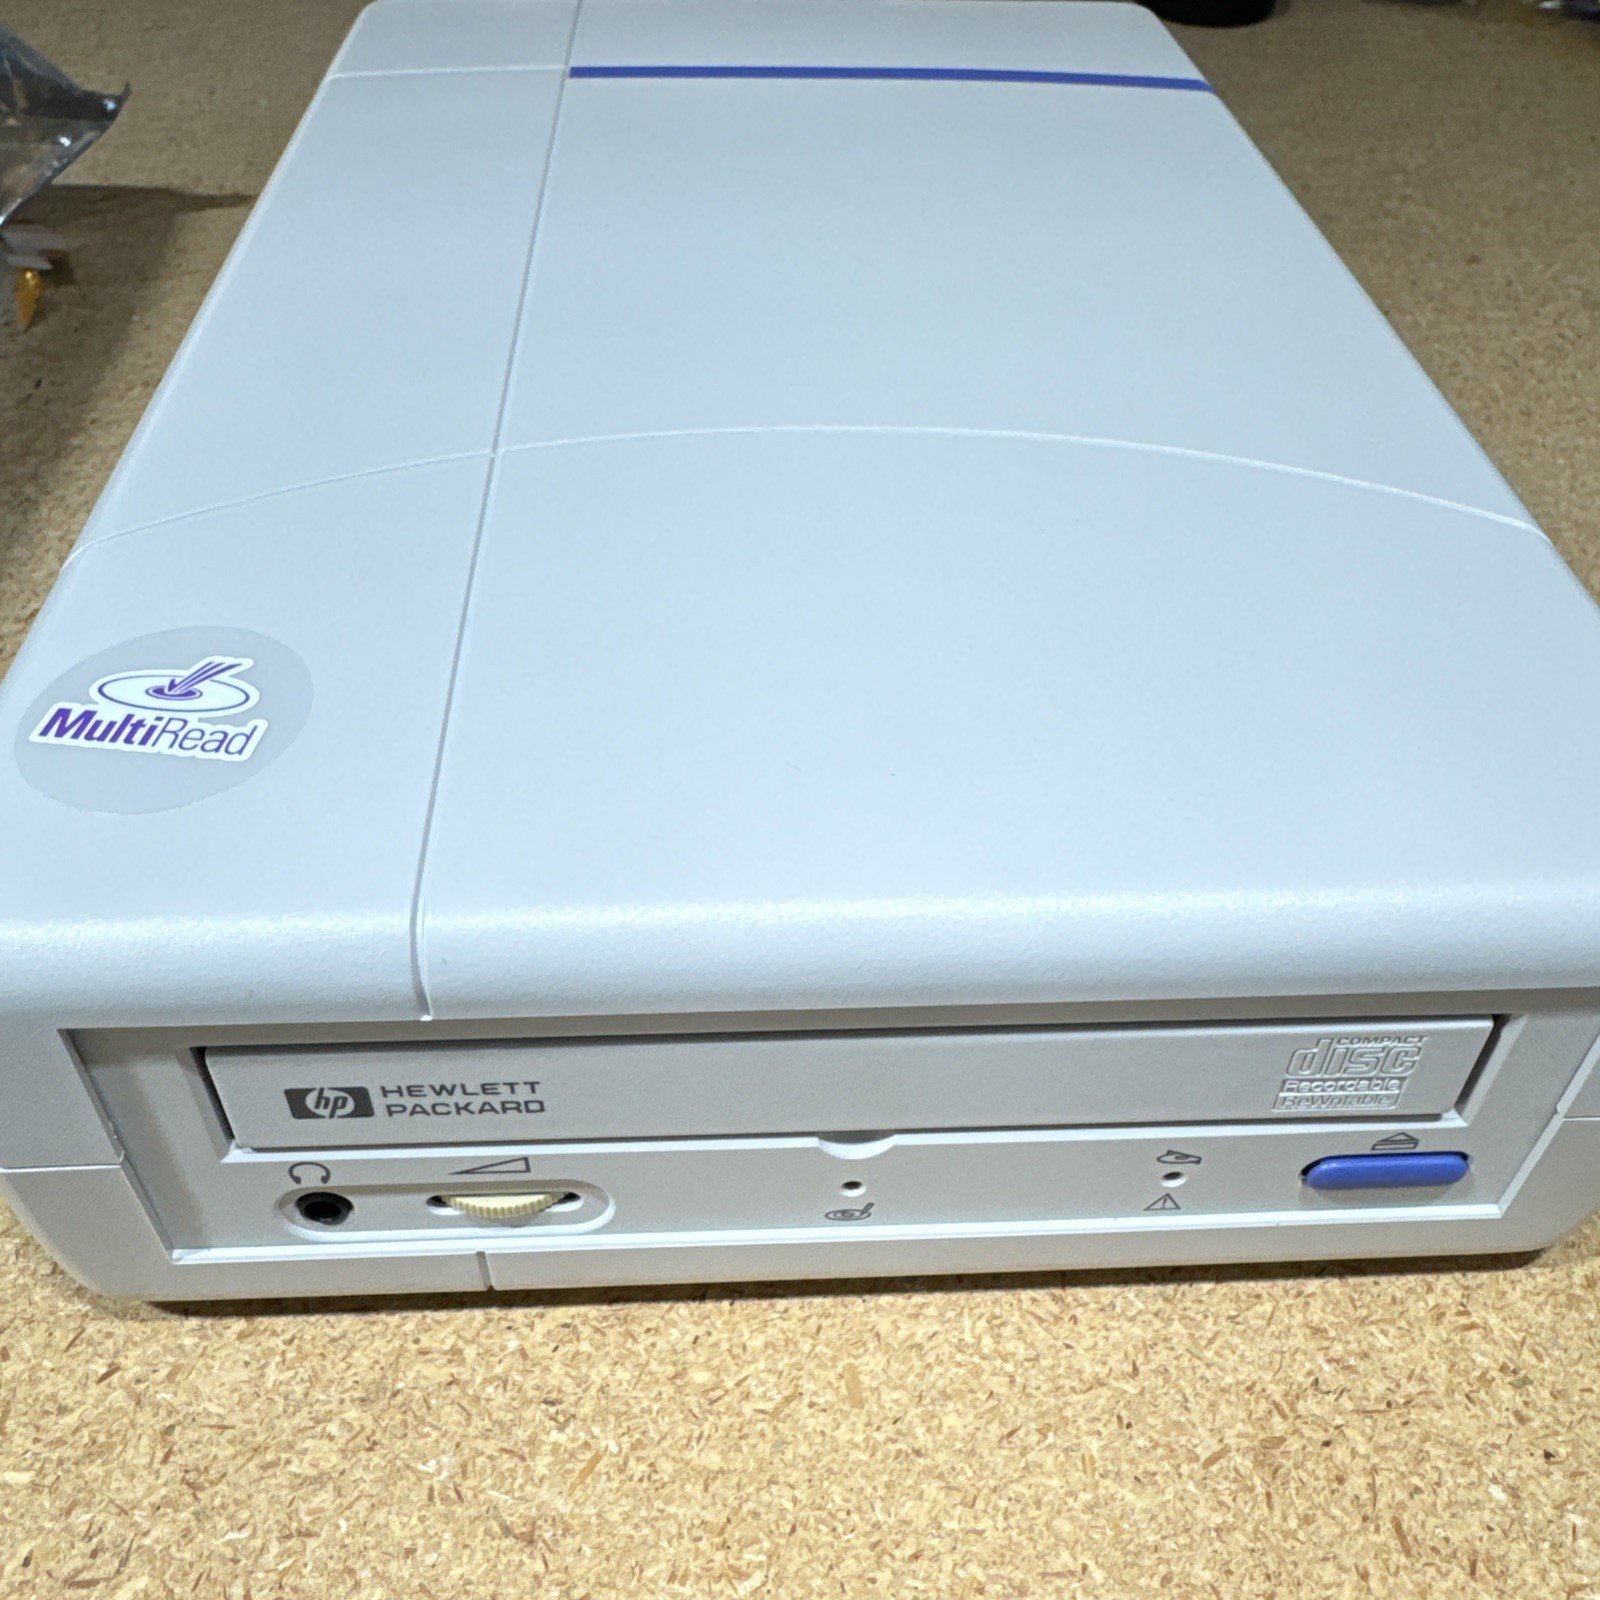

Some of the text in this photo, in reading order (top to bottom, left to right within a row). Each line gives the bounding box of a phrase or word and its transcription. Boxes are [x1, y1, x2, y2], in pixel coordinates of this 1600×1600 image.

[38, 707, 259, 756] MultiRead
[1335, 1035, 1428, 1048] COMPACT
[1285, 1037, 1423, 1079] disc
[380, 1081, 542, 1098] HEWLETT
[1283, 1078, 1401, 1094] Recordable
[314, 1087, 349, 1119] hp
[386, 1099, 546, 1117] PACKARD
